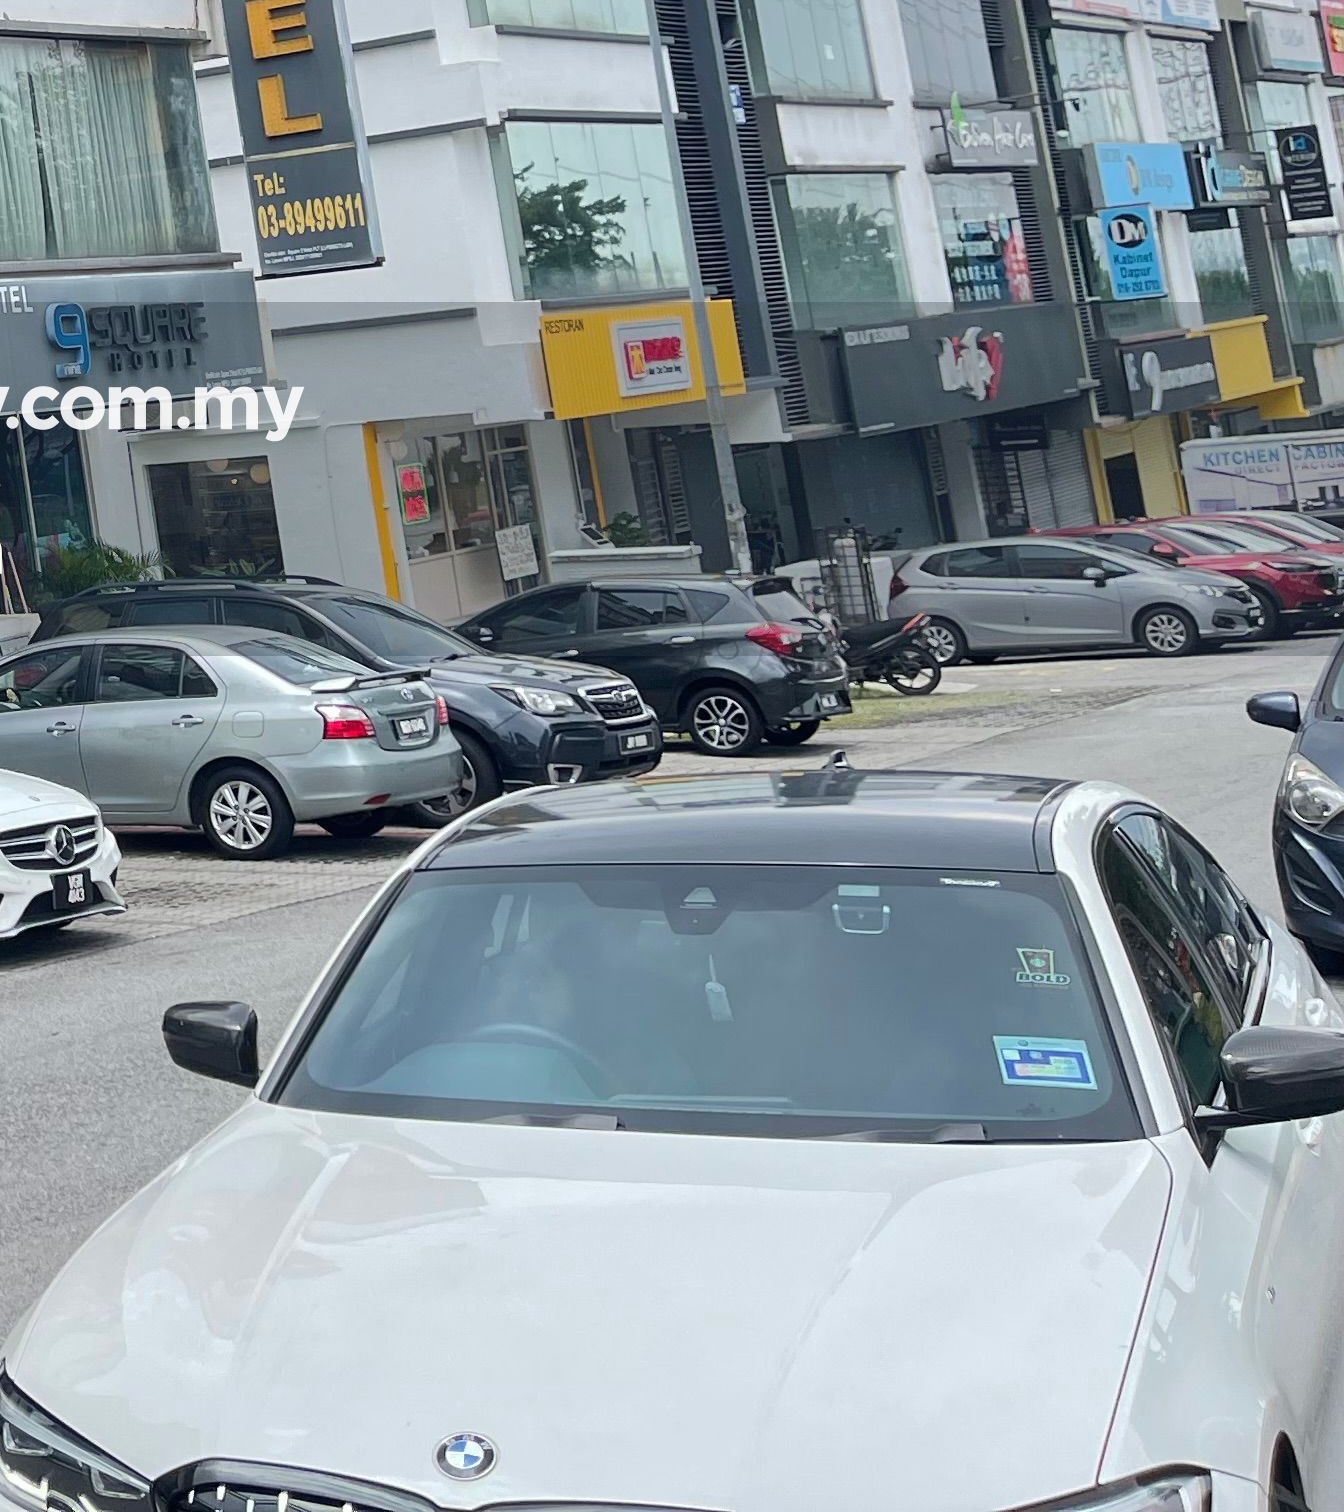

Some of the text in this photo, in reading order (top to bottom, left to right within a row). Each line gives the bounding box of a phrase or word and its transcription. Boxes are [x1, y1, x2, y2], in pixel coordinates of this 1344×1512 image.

[257, 192, 366, 239] 03-89499611
[544, 318, 585, 335] RESTORAN
[44, 301, 209, 379] 9 SQUARE
[1203, 447, 1280, 467] KITCHEN
[1018, 972, 1070, 984] BOLD
